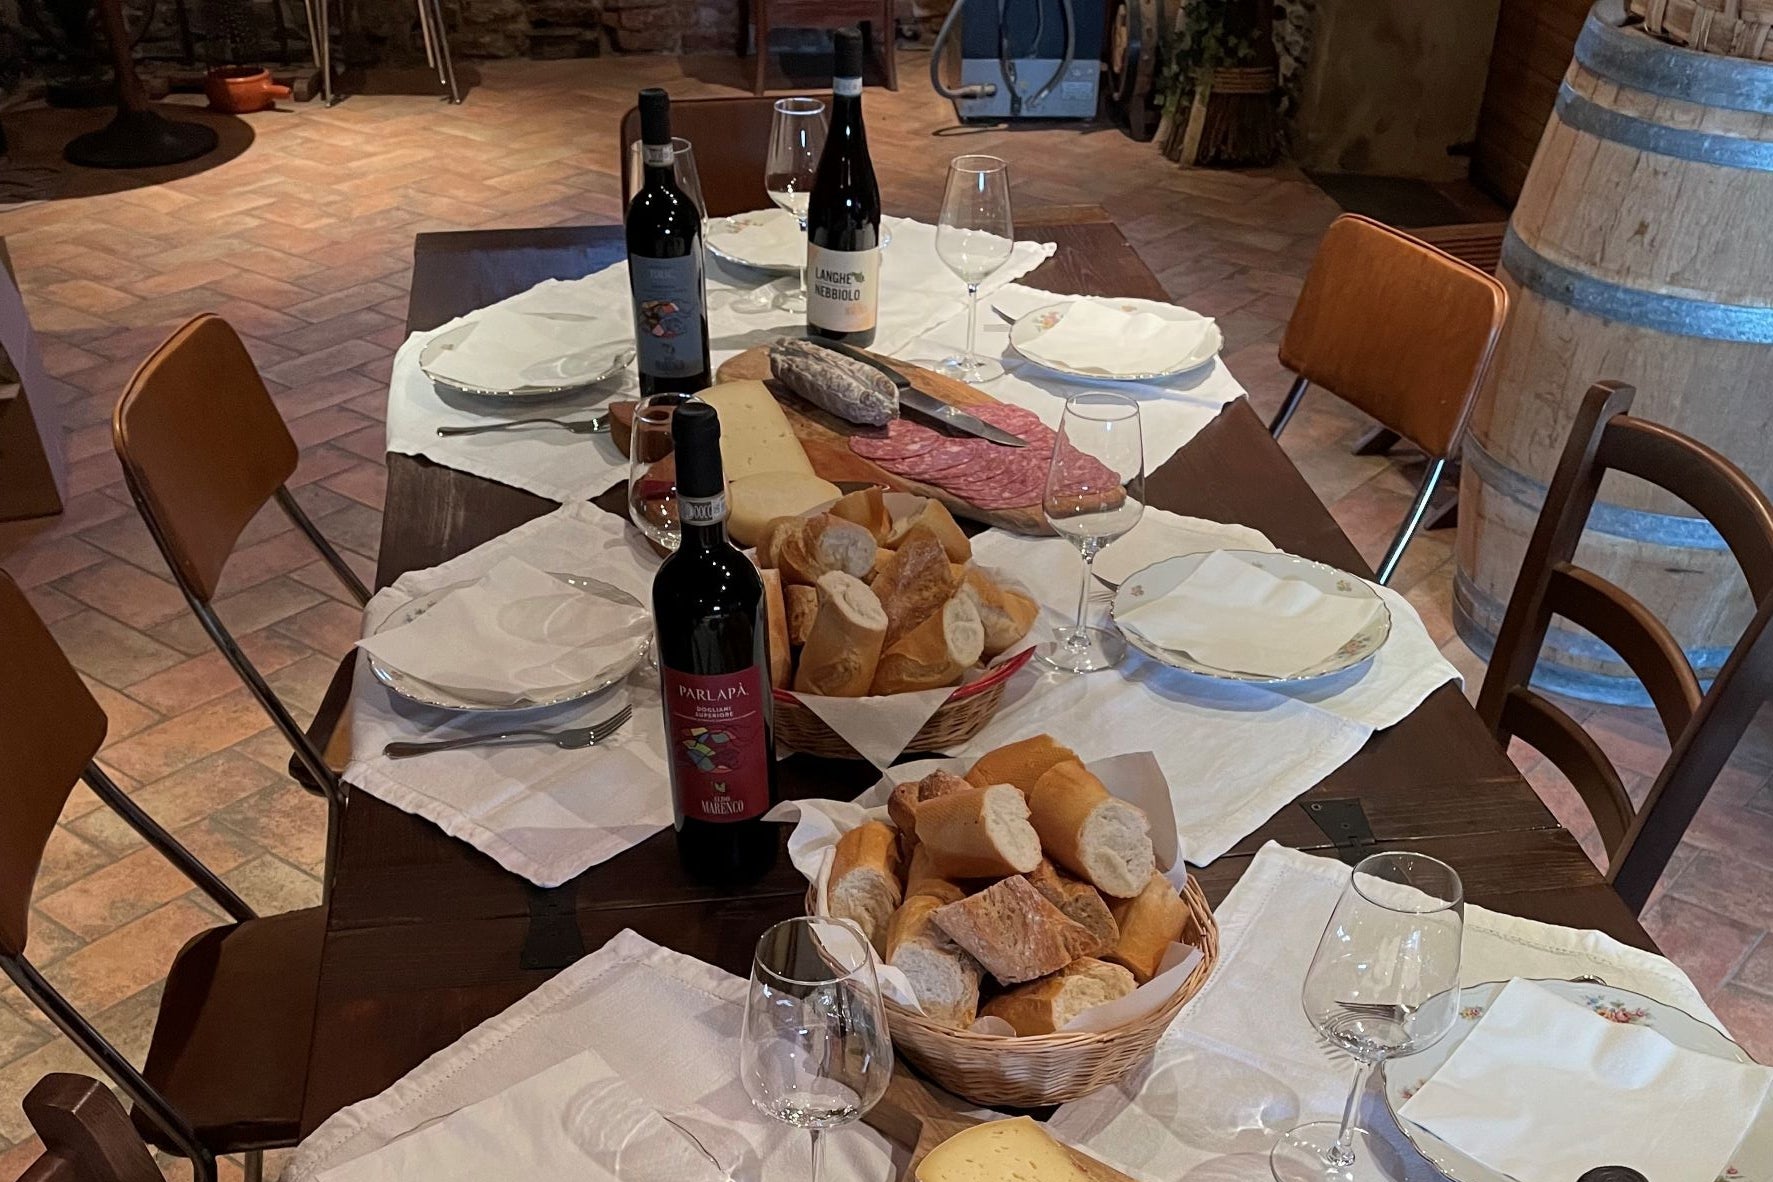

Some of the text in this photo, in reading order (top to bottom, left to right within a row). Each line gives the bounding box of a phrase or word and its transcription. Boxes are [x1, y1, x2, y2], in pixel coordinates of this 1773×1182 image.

[815, 267, 853, 285] LANGHE
[815, 283, 861, 301] NEBBIOLO
[701, 799, 744, 815] MARENCO
